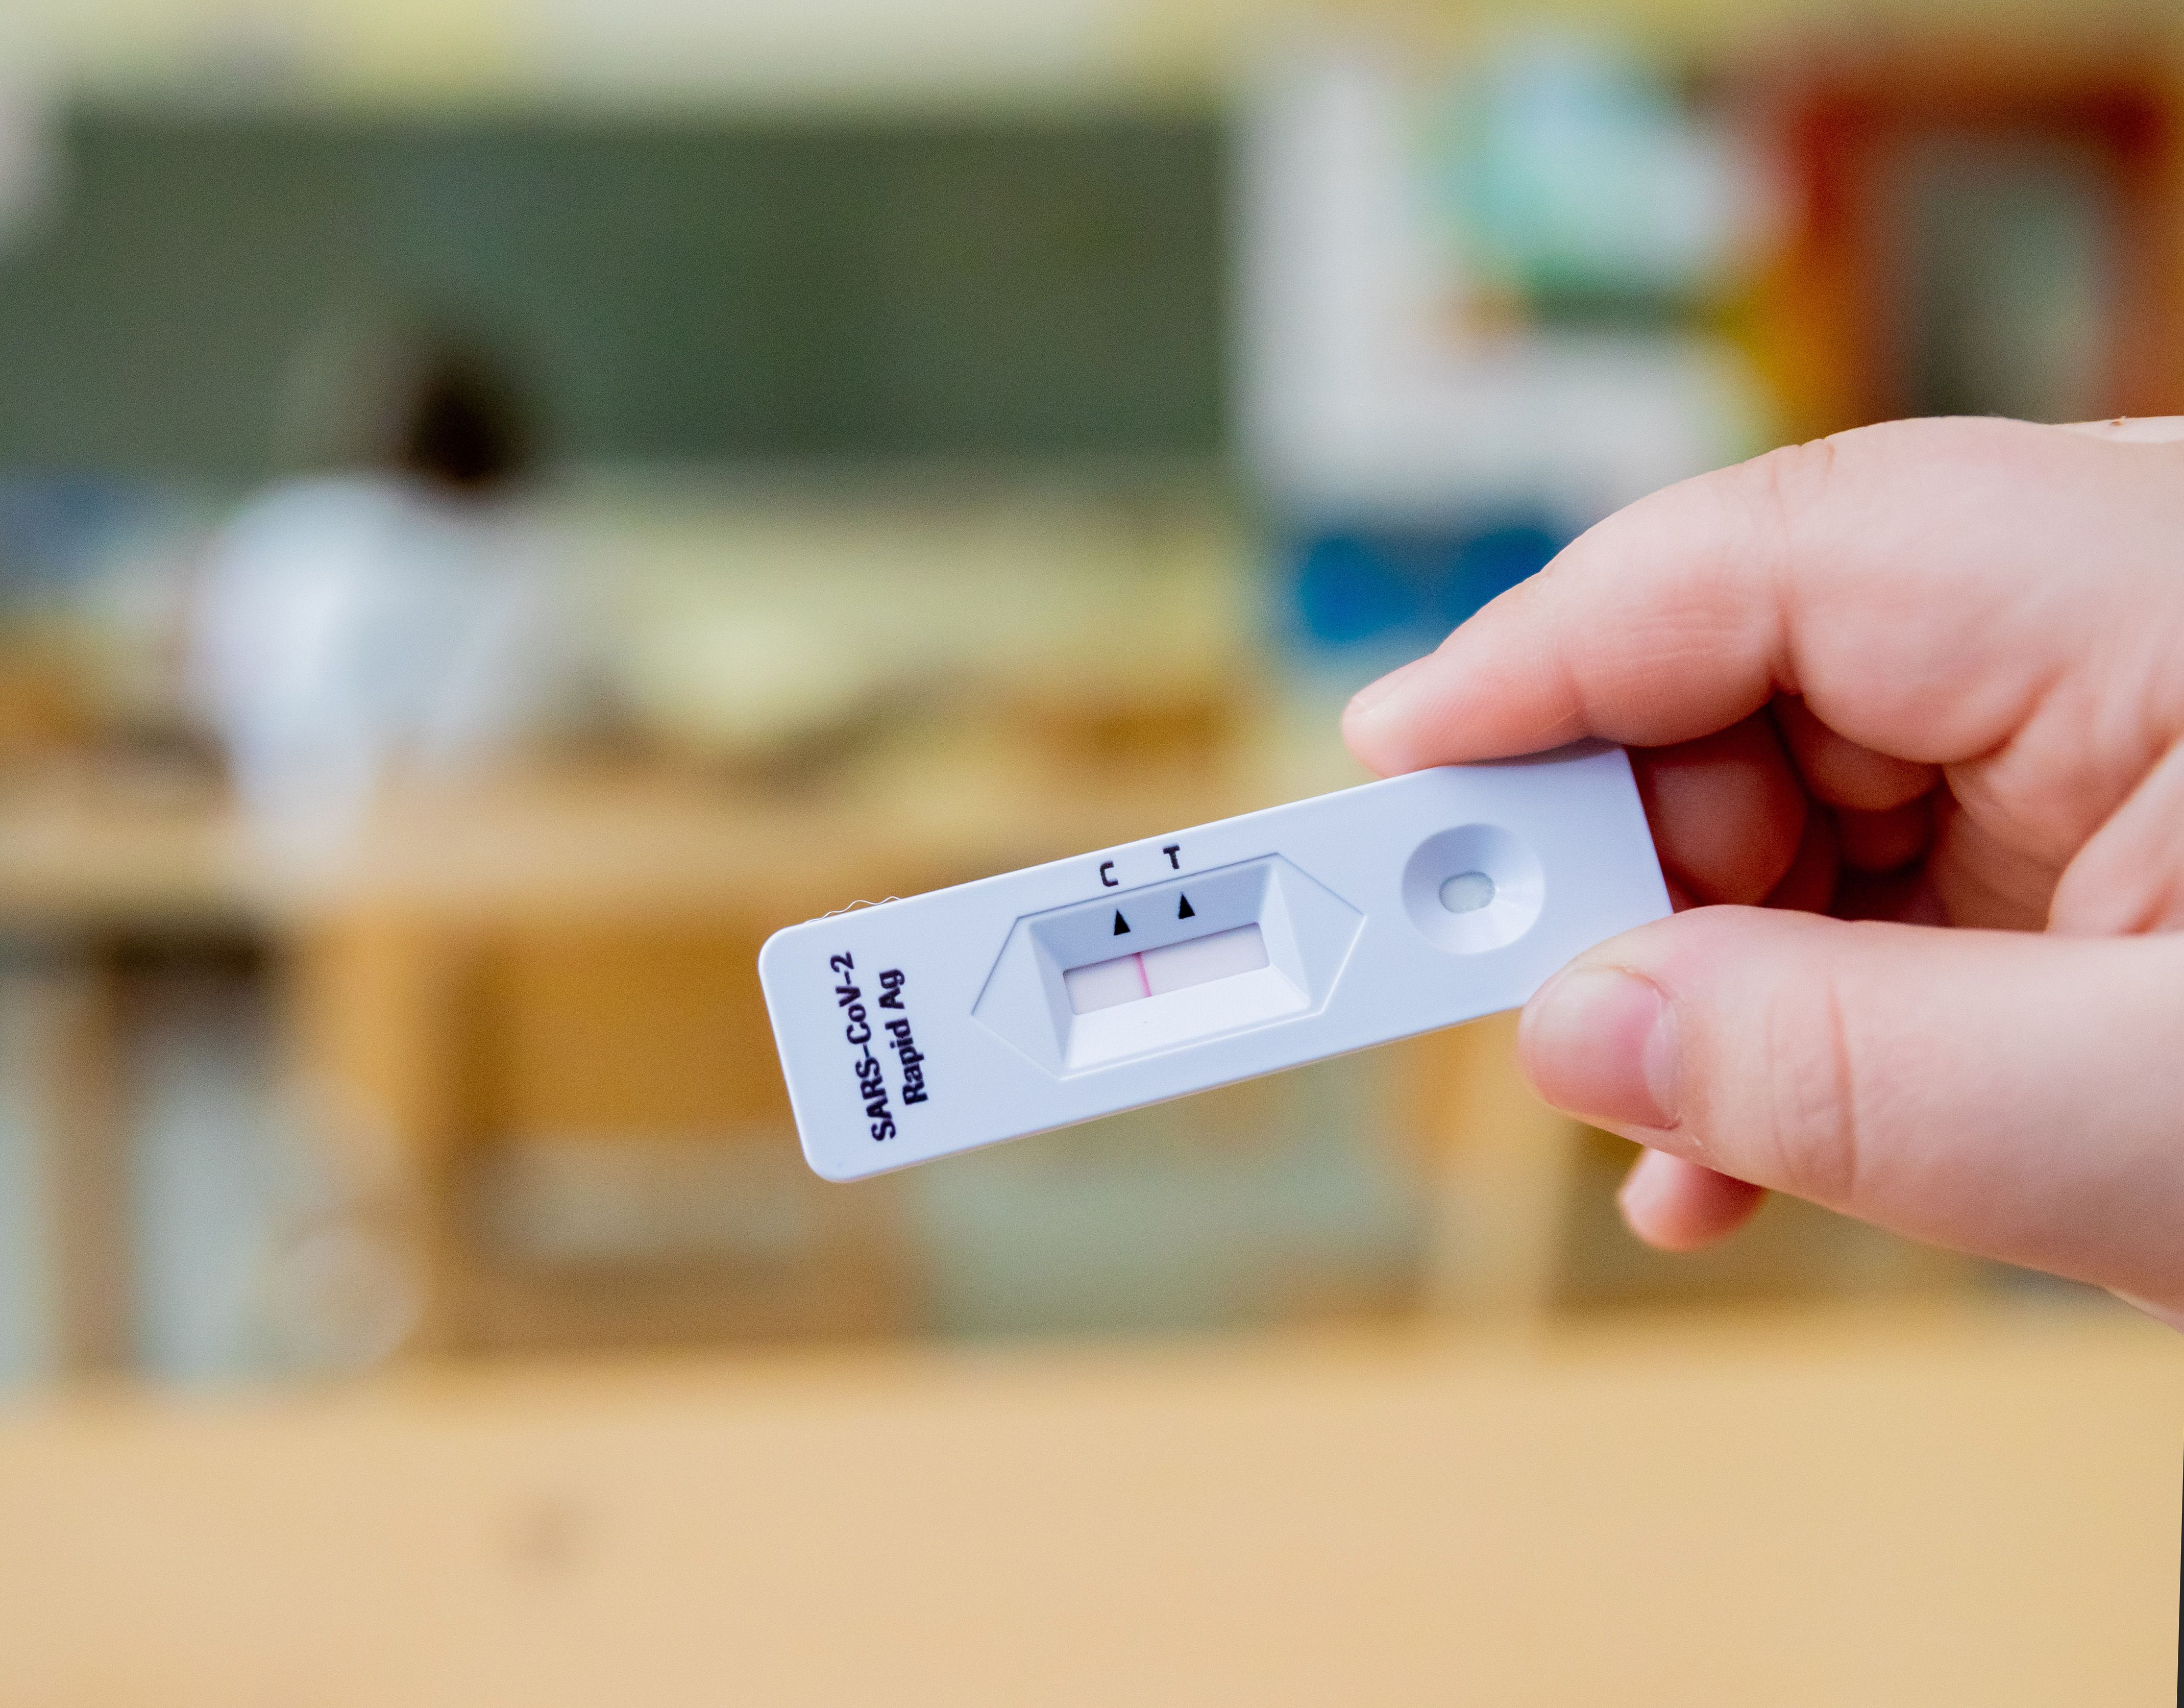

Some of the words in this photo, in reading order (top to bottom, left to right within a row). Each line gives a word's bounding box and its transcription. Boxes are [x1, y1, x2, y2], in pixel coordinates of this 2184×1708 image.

[1099, 861, 1119, 888] C
[1162, 844, 1181, 870] T
[878, 969, 905, 1009] Ag
[830, 951, 896, 1142] SARS-CoV-2
[885, 1018, 928, 1106] Rapid
